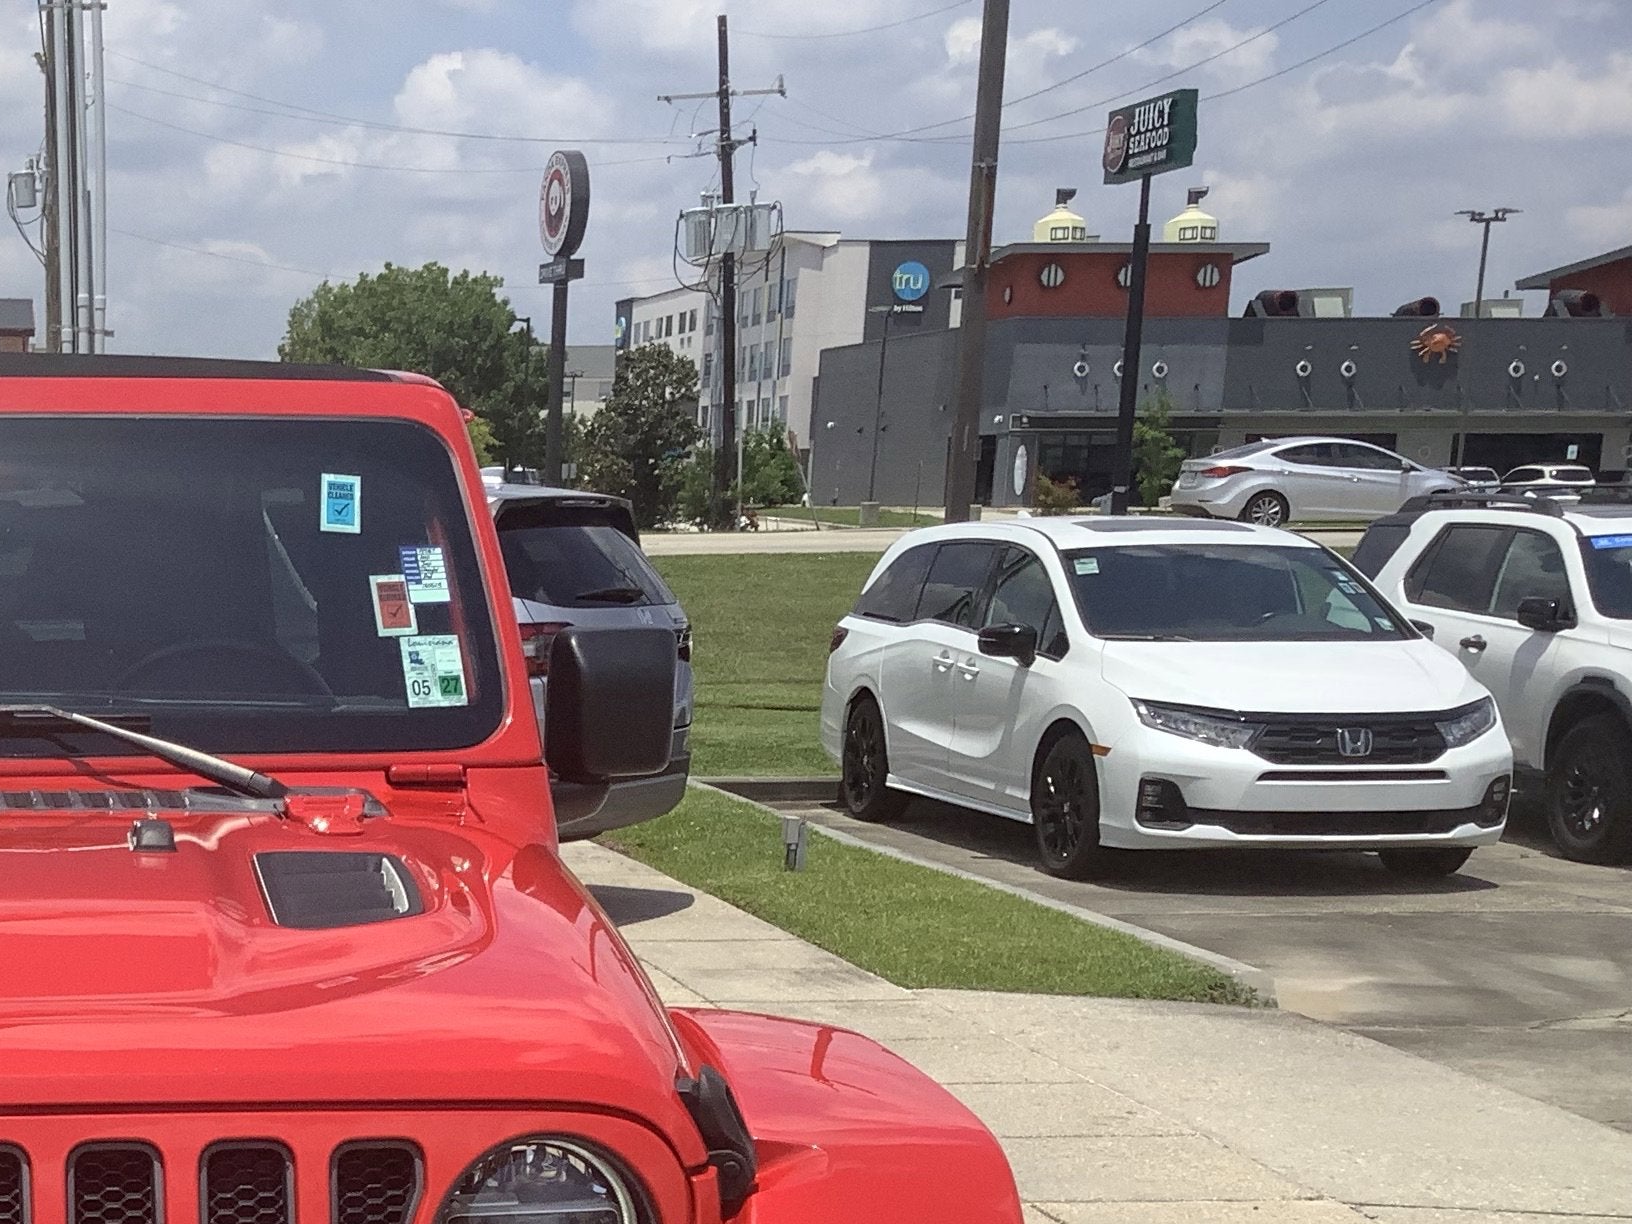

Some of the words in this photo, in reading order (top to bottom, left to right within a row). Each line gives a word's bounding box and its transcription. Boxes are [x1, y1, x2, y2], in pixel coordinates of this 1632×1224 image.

[1129, 97, 1173, 135] JUICY
[1128, 127, 1170, 155] SEAFOOD
[894, 269, 923, 290] tru
[893, 304, 902, 313] by
[902, 304, 923, 312] Hilton
[328, 483, 354, 492] VEHICLE
[408, 637, 454, 648] Louisiana
[411, 679, 431, 696] 05
[441, 677, 460, 694] 27
